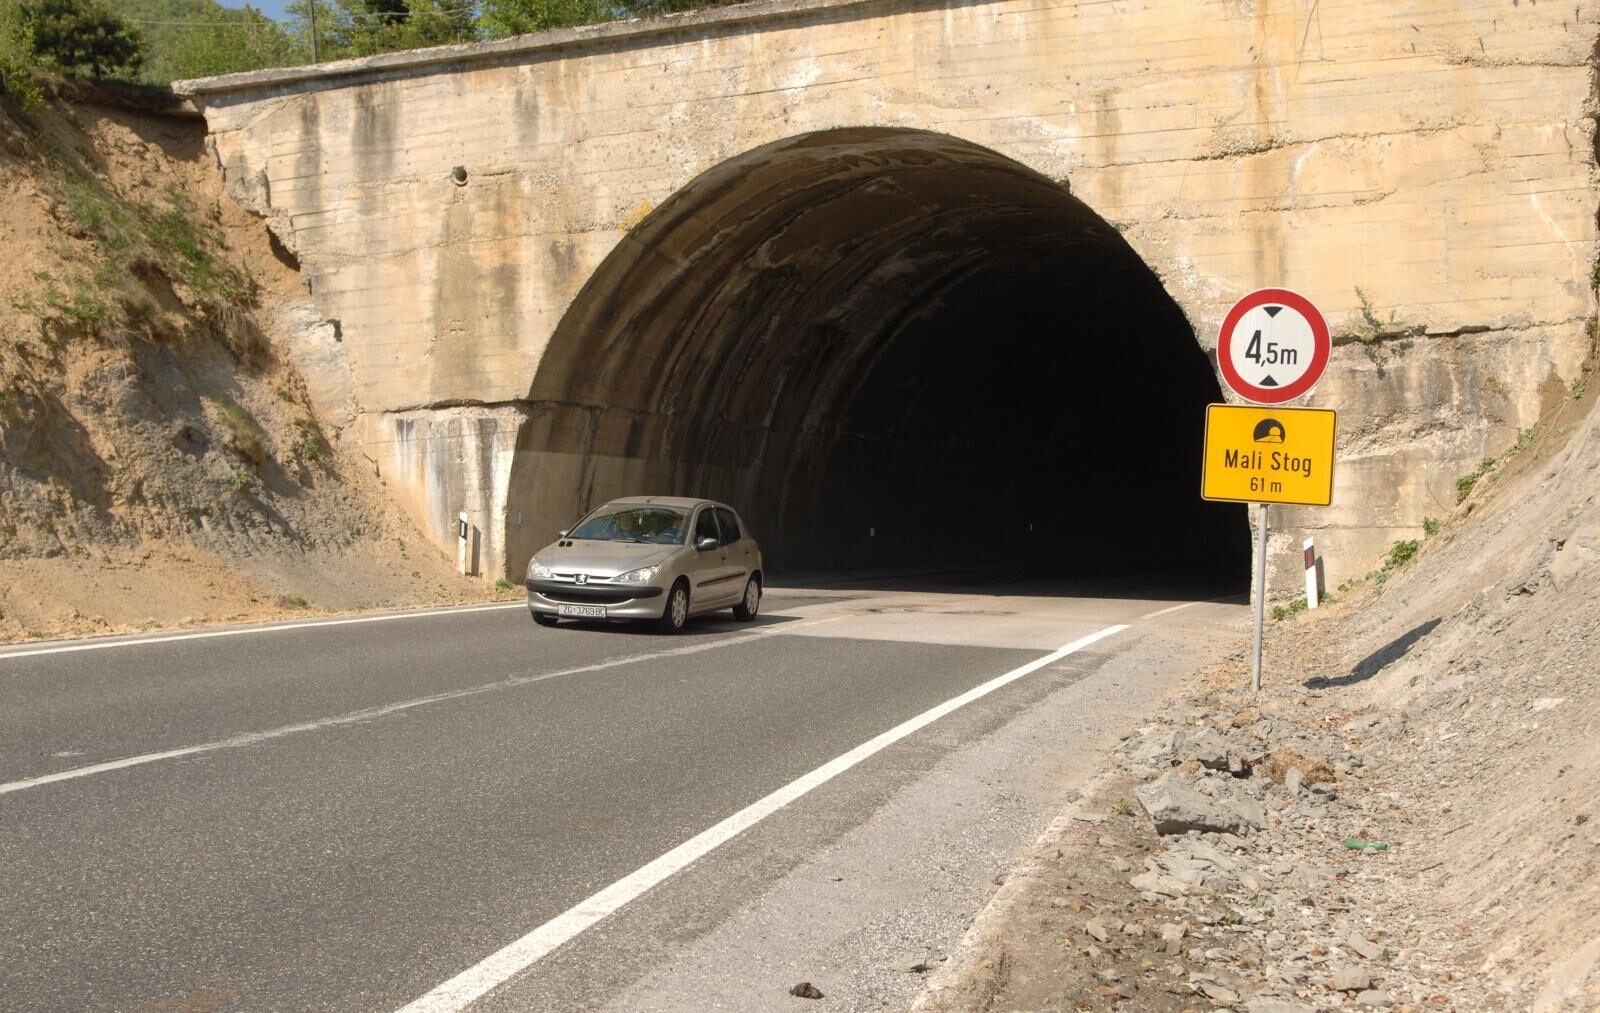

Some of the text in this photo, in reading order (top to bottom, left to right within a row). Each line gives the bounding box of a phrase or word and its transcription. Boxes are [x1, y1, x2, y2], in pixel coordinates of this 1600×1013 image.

[1225, 449, 1312, 477] Mali Stog
[1250, 477, 1282, 493] 61 m
